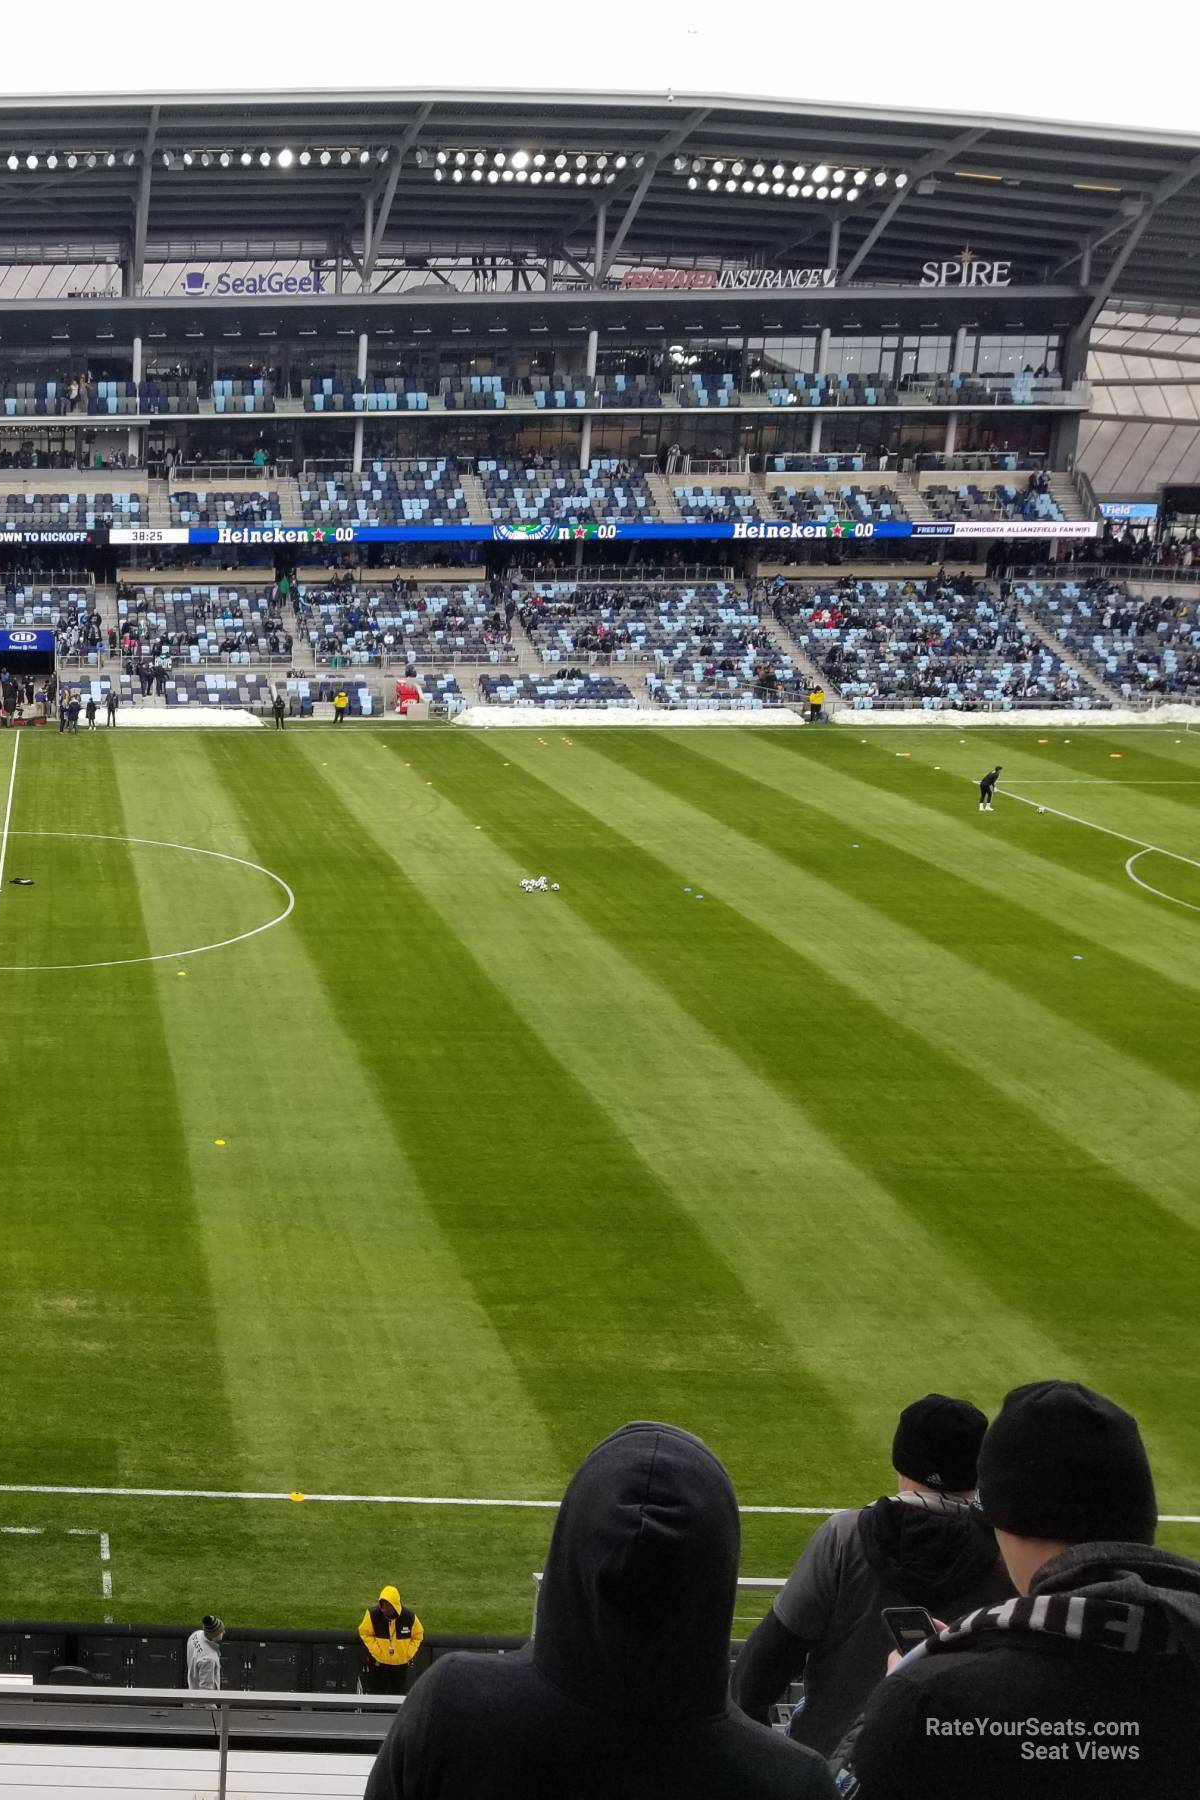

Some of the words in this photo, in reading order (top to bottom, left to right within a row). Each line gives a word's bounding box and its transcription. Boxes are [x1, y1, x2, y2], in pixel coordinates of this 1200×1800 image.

[719, 269, 822, 288] INSURANCE
[920, 261, 1012, 286] SPIRE
[217, 272, 325, 294] SeatGeek
[24, 532, 38, 542] TO
[40, 532, 87, 542] KICKOFF
[132, 531, 163, 541] 38:25
[218, 528, 308, 543] Heineken
[733, 522, 827, 538] Heineken
